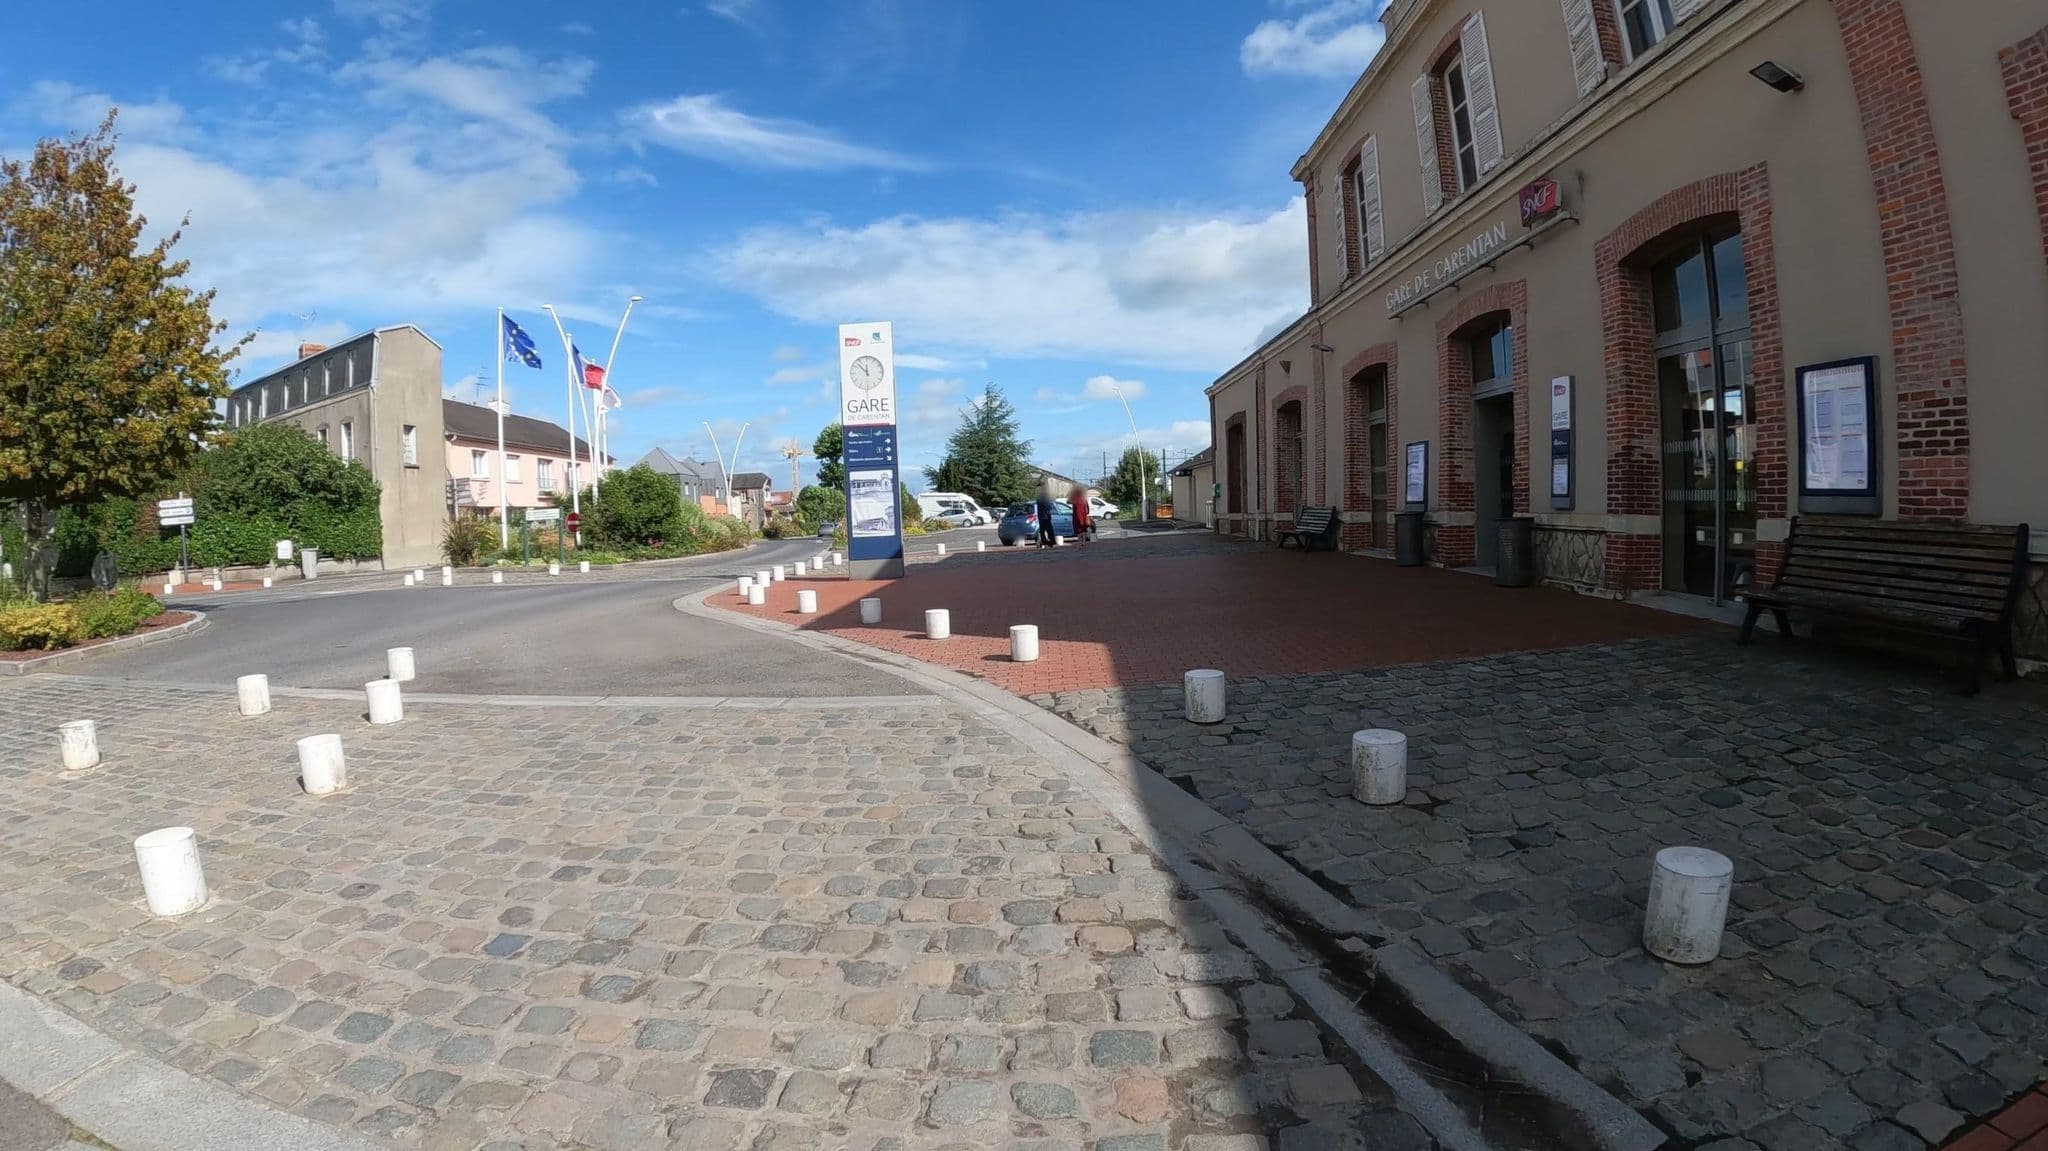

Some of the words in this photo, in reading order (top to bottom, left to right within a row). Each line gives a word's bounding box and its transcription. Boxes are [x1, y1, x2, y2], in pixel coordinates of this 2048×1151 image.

[1522, 184, 1552, 221] SNCF
[1385, 279, 1412, 311] GARE
[1414, 269, 1431, 294] DE
[1434, 222, 1507, 280] CARENTAN
[847, 398, 889, 413] GARE
